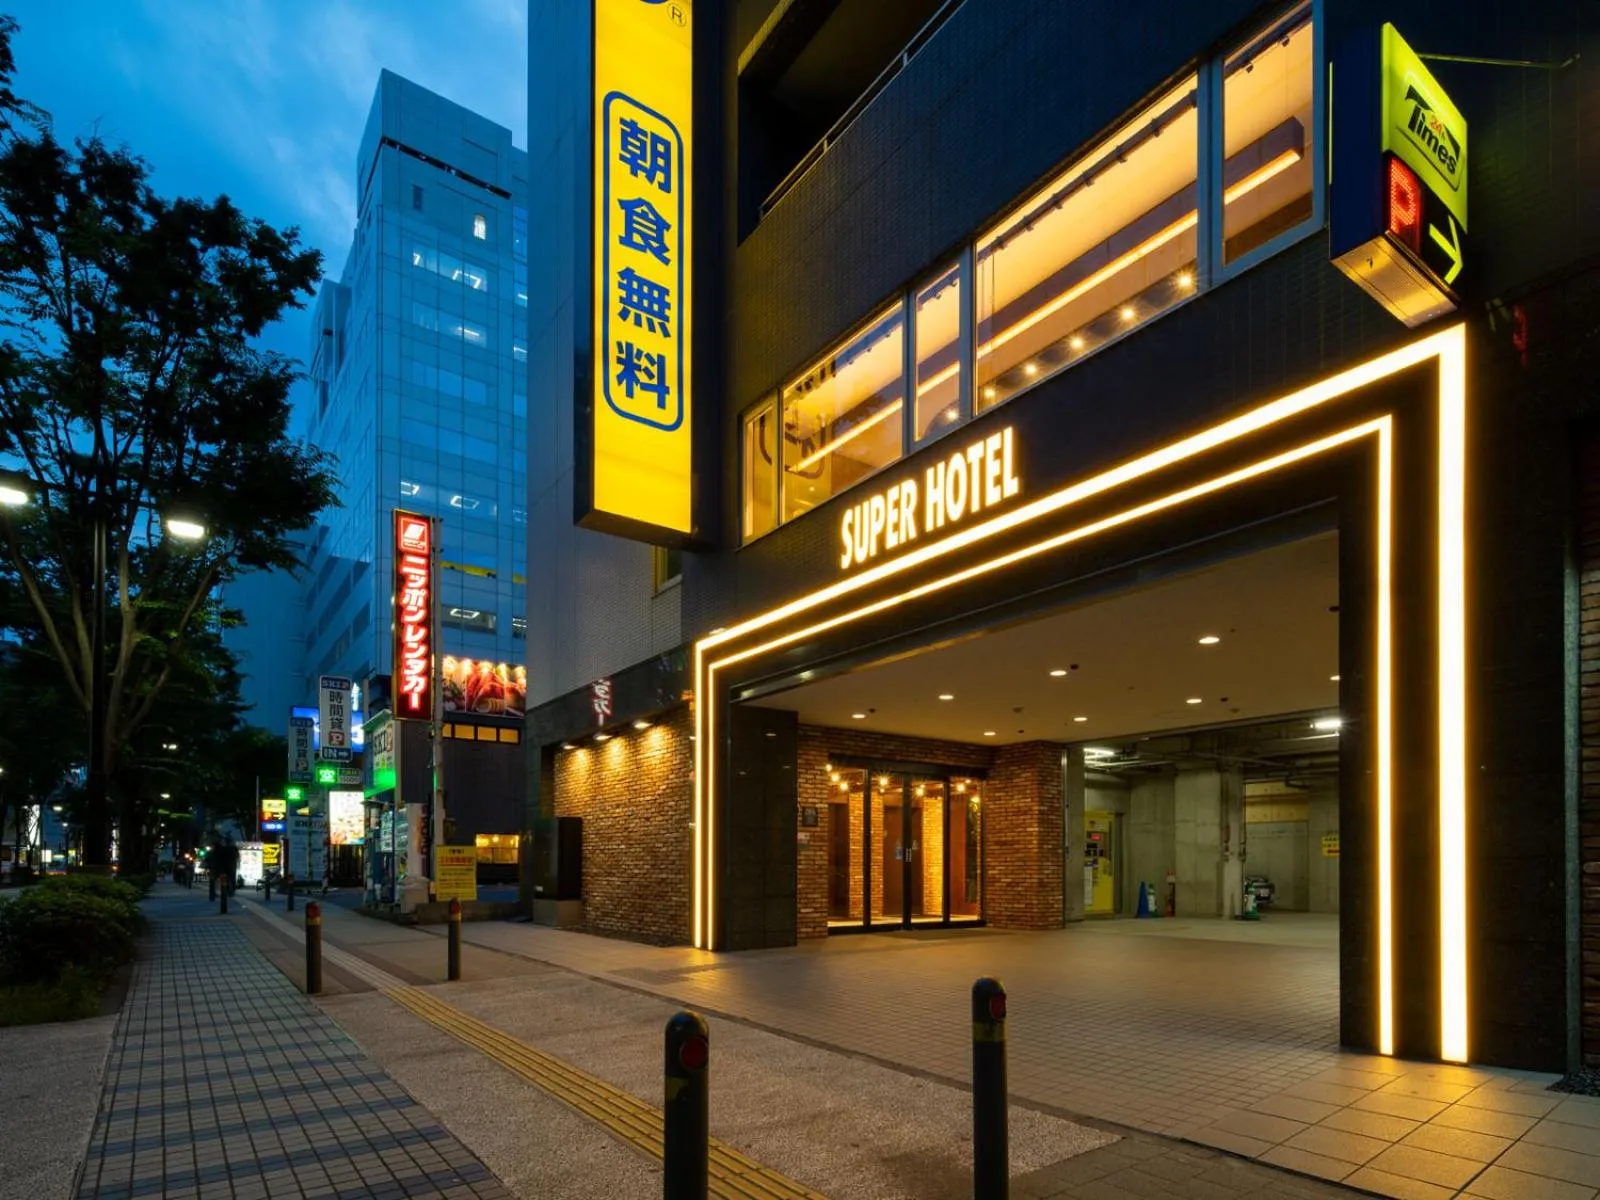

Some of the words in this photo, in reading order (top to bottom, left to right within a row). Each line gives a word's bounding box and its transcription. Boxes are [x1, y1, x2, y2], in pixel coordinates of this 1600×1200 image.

[1391, 160, 1417, 232] P
[1405, 84, 1460, 175] Times
[617, 117, 671, 410] 朝食無料
[841, 479, 917, 569] SUPER
[926, 426, 1019, 532] HOTEL
[402, 555, 428, 709] ニッポンレンタカー
